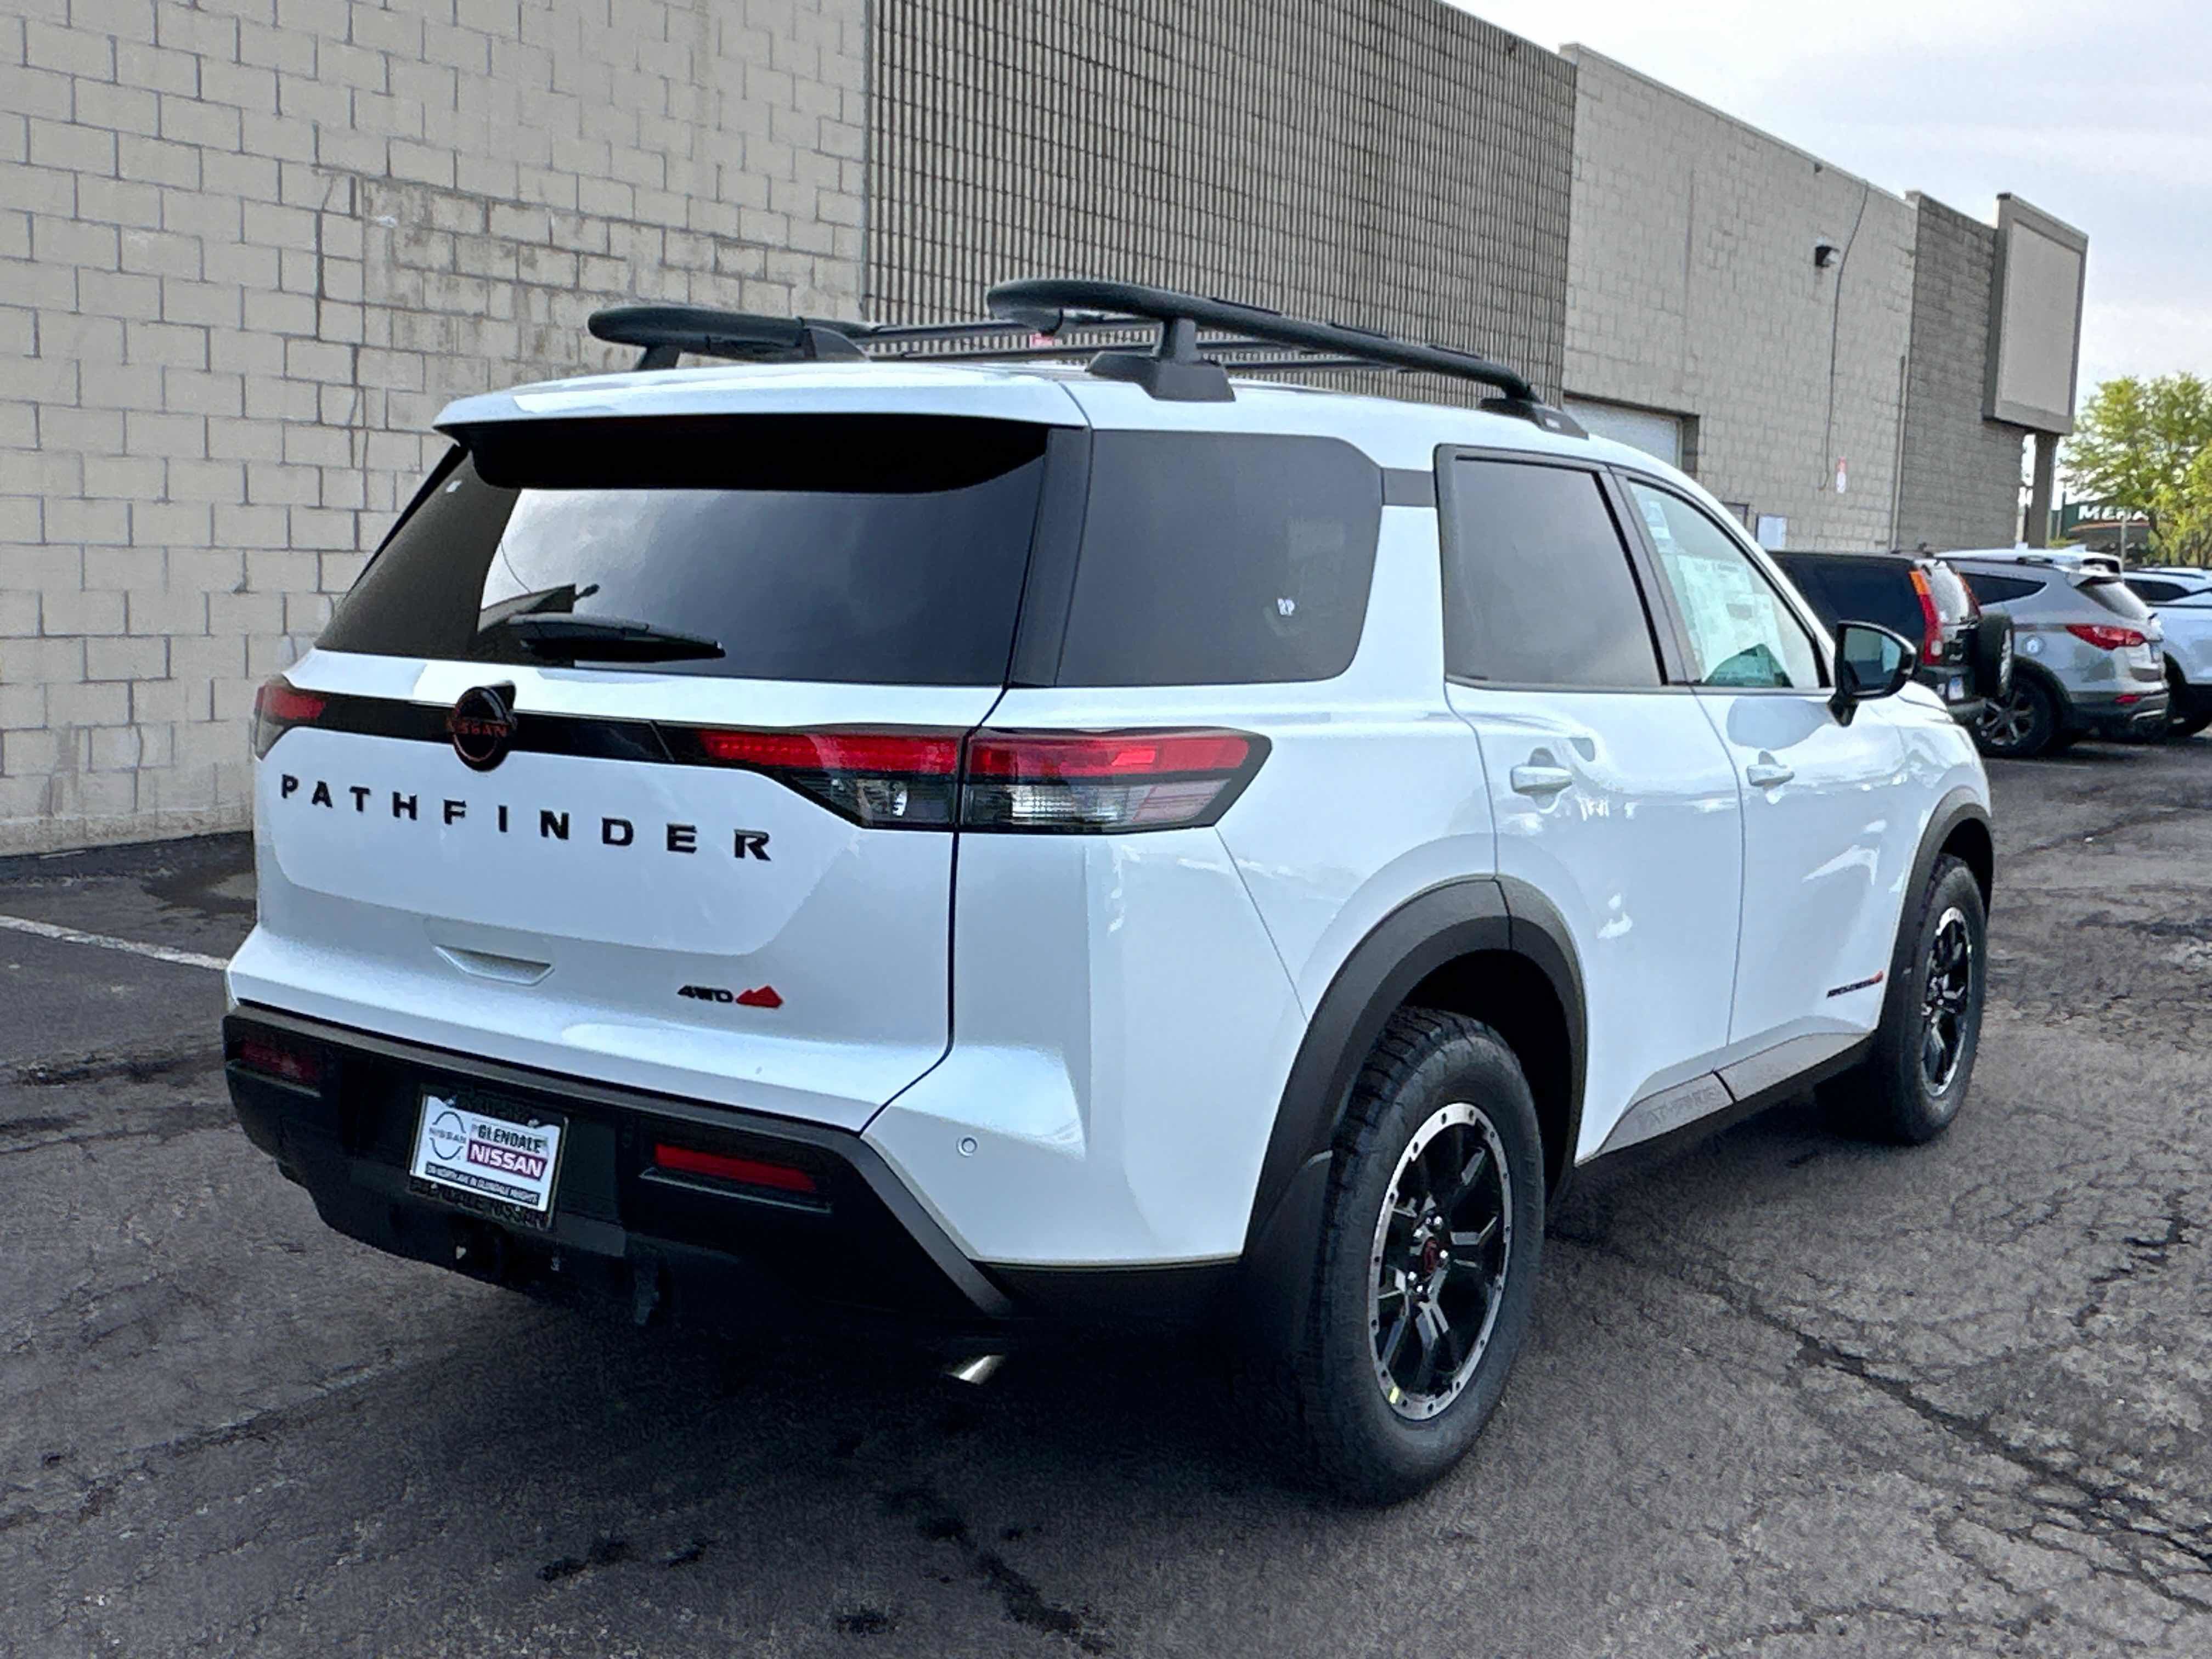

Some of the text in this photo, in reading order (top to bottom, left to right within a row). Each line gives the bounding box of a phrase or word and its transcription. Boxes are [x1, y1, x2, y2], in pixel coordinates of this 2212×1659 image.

[281, 774, 772, 861] PATHFINDER
[677, 985, 733, 1003] 4WD
[478, 1124, 542, 1154] GLENDALE
[470, 1143, 543, 1178] NISSAN
